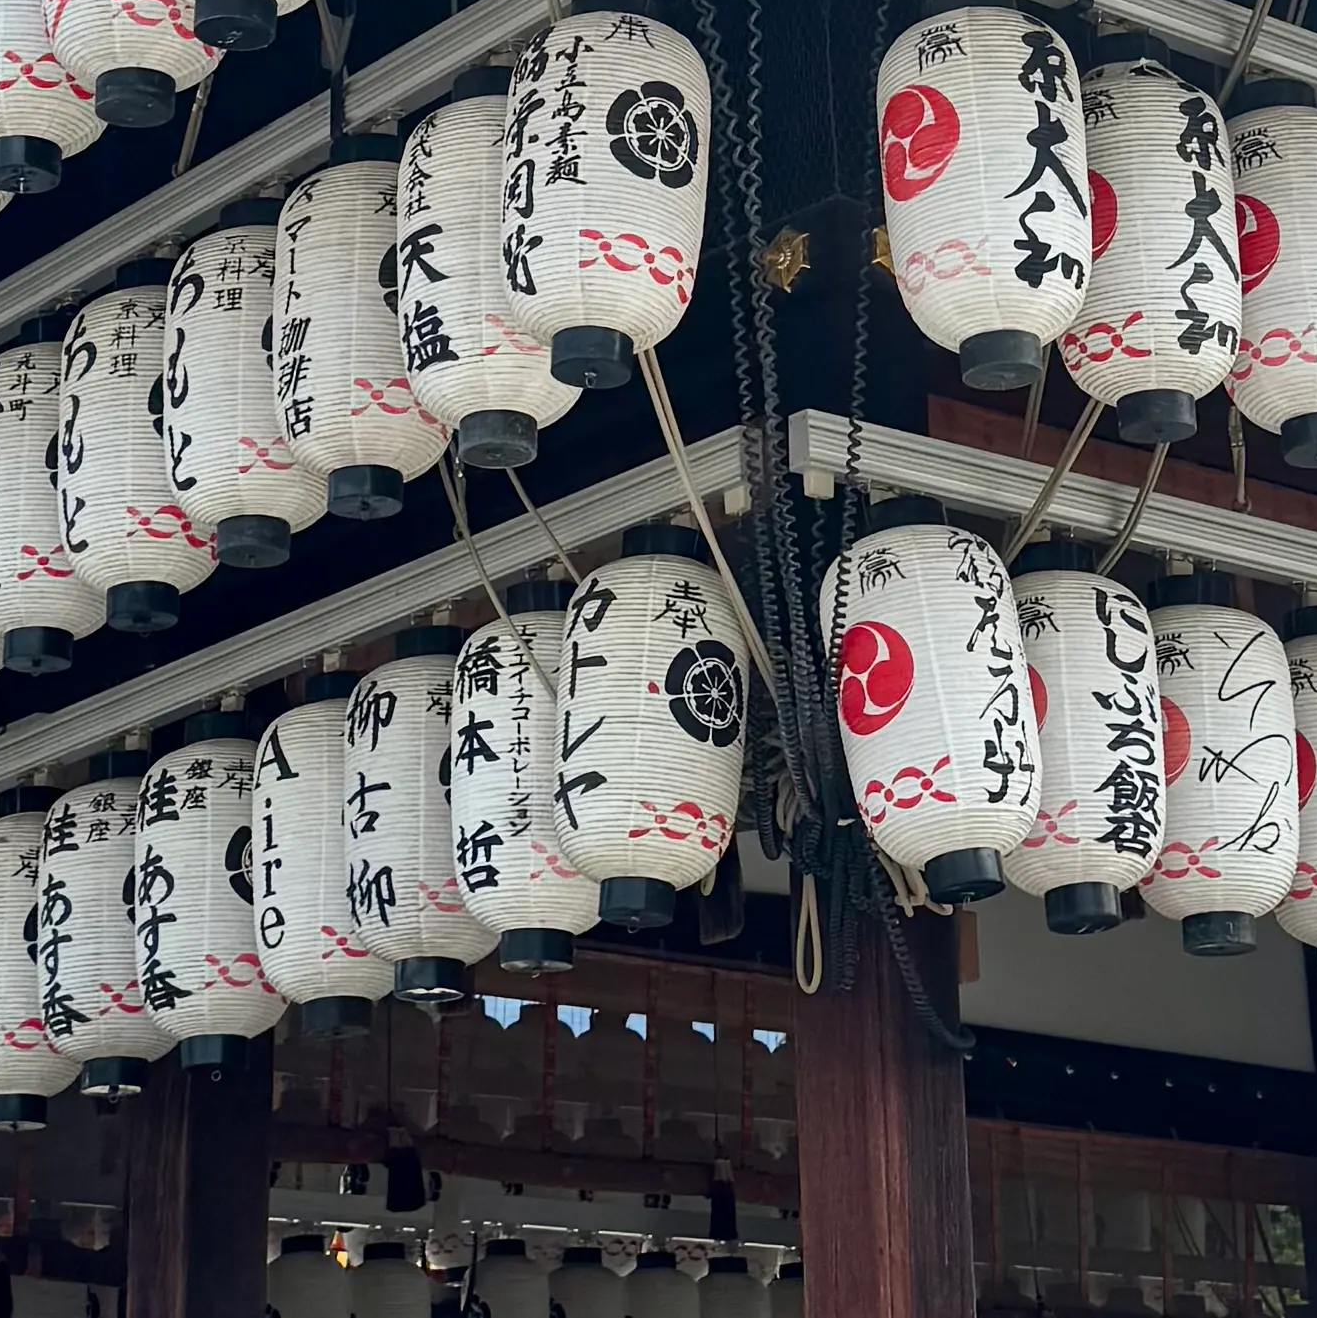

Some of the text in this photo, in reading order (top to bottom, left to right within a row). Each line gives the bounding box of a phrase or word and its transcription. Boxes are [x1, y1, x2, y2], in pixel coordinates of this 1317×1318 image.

[545, 35, 595, 187] 小豆島素麺
[109, 298, 140, 378] 京料理
[277, 178, 323, 442] スマート珈琲店
[8, 351, 36, 422] 先斗町
[651, 579, 714, 639] 奉
[553, 577, 618, 831] カトレヤ
[1091, 586, 1162, 858] にしぶち飯店
[85, 792, 117, 844] 銀座
[181, 758, 215, 811] 銀座
[254, 724, 300, 950] Aire
